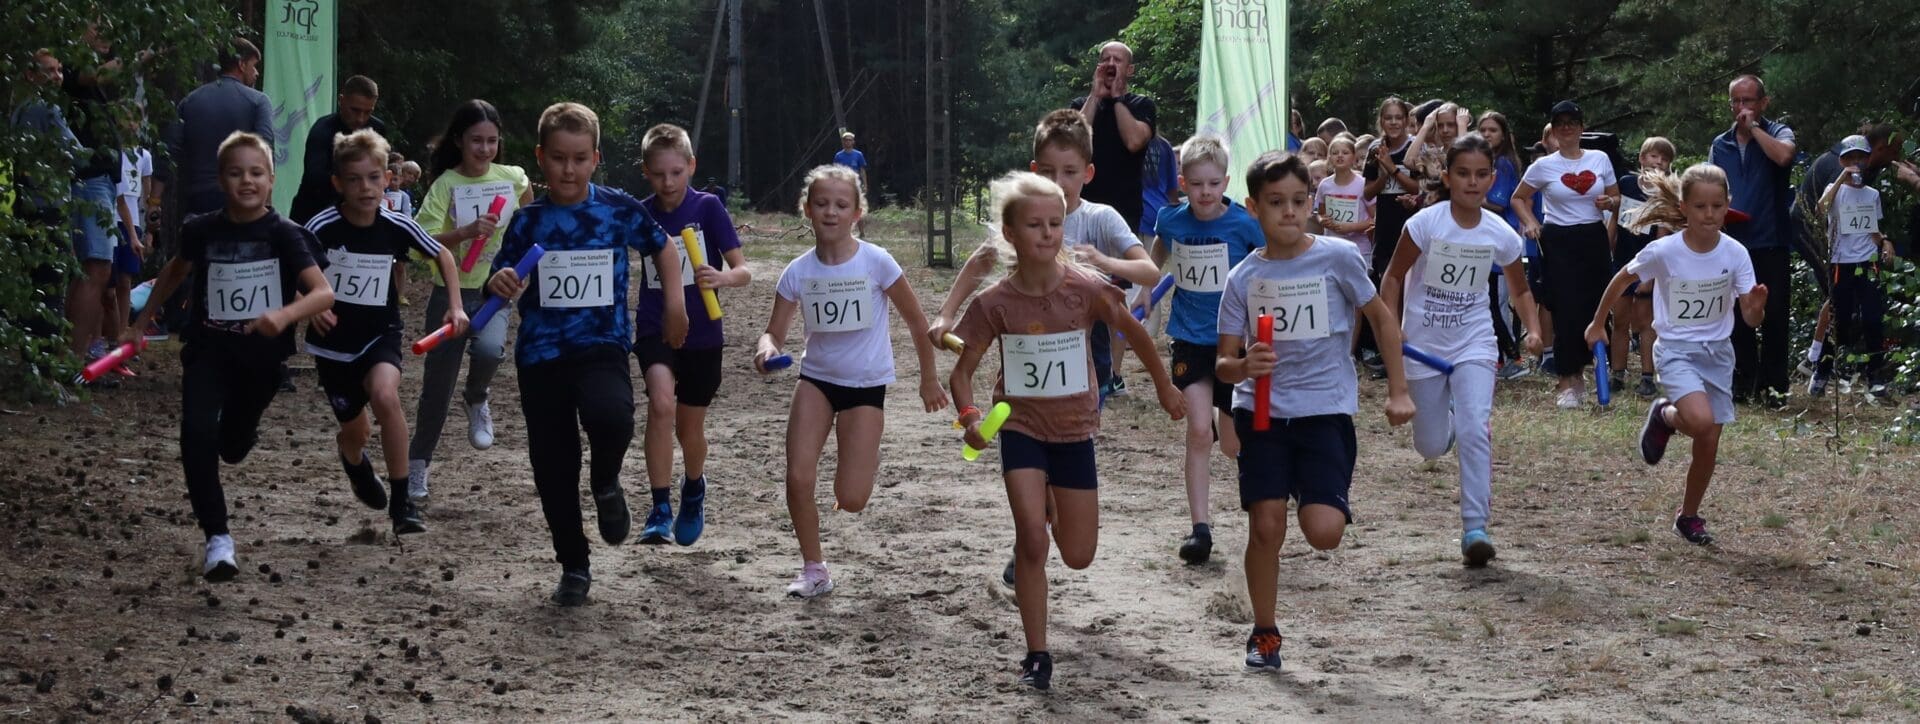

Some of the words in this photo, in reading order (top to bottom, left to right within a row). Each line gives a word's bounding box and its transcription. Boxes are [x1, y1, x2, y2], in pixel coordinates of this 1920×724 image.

[1328, 207, 1354, 223] 22/2
[1850, 215, 1871, 229] 4/2
[334, 273, 380, 298] 15/1
[548, 274, 602, 300] 20/1
[1177, 263, 1218, 287] 14/1
[1440, 263, 1476, 287] 8/1
[217, 285, 270, 312] 16/1
[1678, 296, 1722, 319] 22/1
[812, 299, 861, 325] 19/1
[1023, 360, 1066, 390] 3/1
